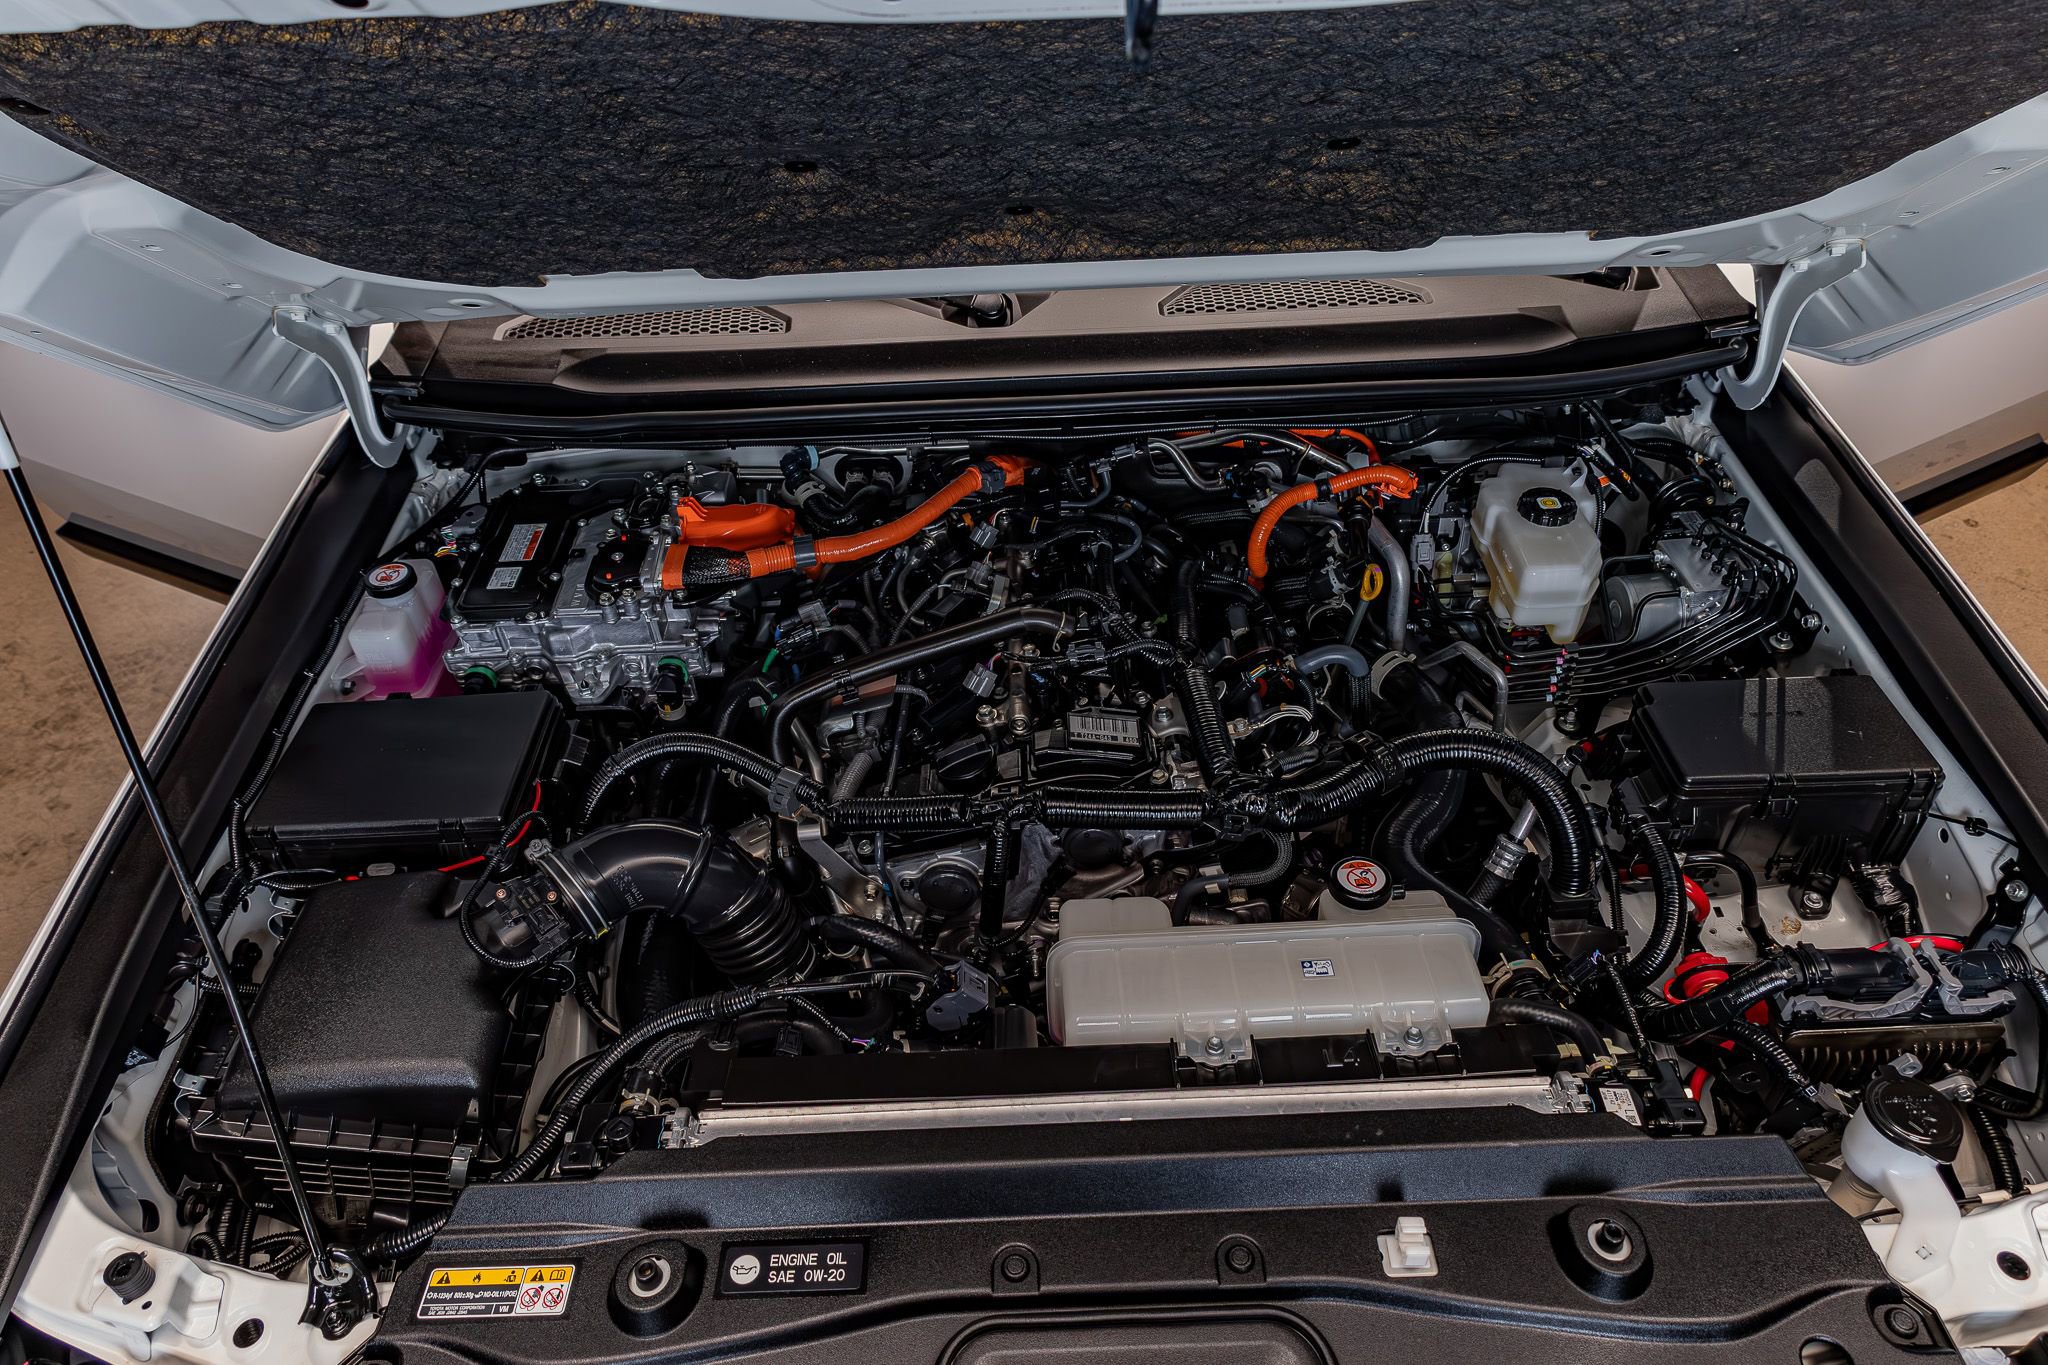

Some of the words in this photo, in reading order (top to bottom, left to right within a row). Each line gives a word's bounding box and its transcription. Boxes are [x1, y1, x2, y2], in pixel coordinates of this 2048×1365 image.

[769, 1253, 819, 1267] ENGINE
[826, 1252, 848, 1265] OIL
[767, 1270, 796, 1283] SAE
[803, 1268, 846, 1282] 0W-20
[499, 1305, 510, 1313] VM
